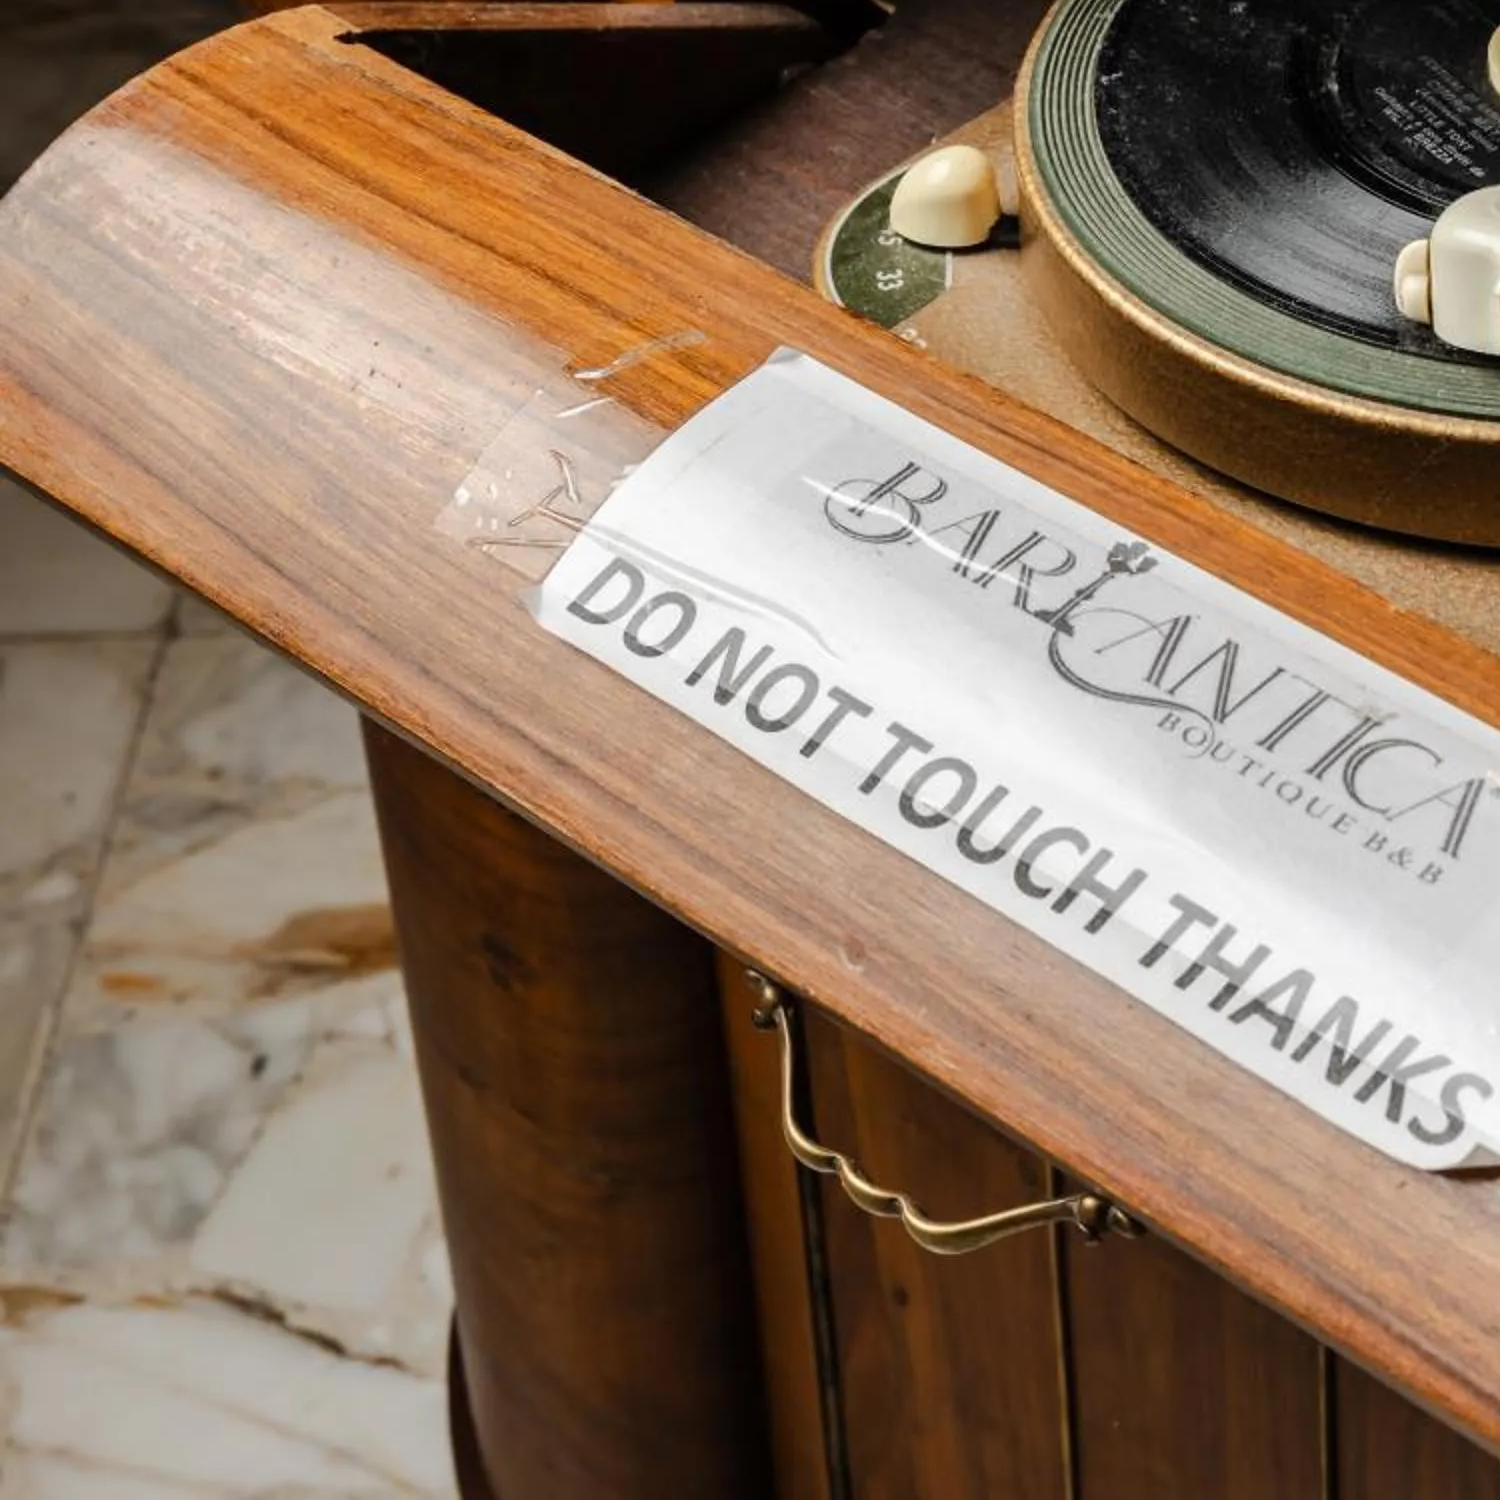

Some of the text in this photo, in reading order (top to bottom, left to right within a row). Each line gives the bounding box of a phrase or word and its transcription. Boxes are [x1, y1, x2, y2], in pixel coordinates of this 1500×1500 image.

[875, 268, 905, 292] 33
[566, 556, 1494, 1146] DO NOT TOUCH THANKS
[1155, 711, 1445, 886] BOUTIQUE B&B
